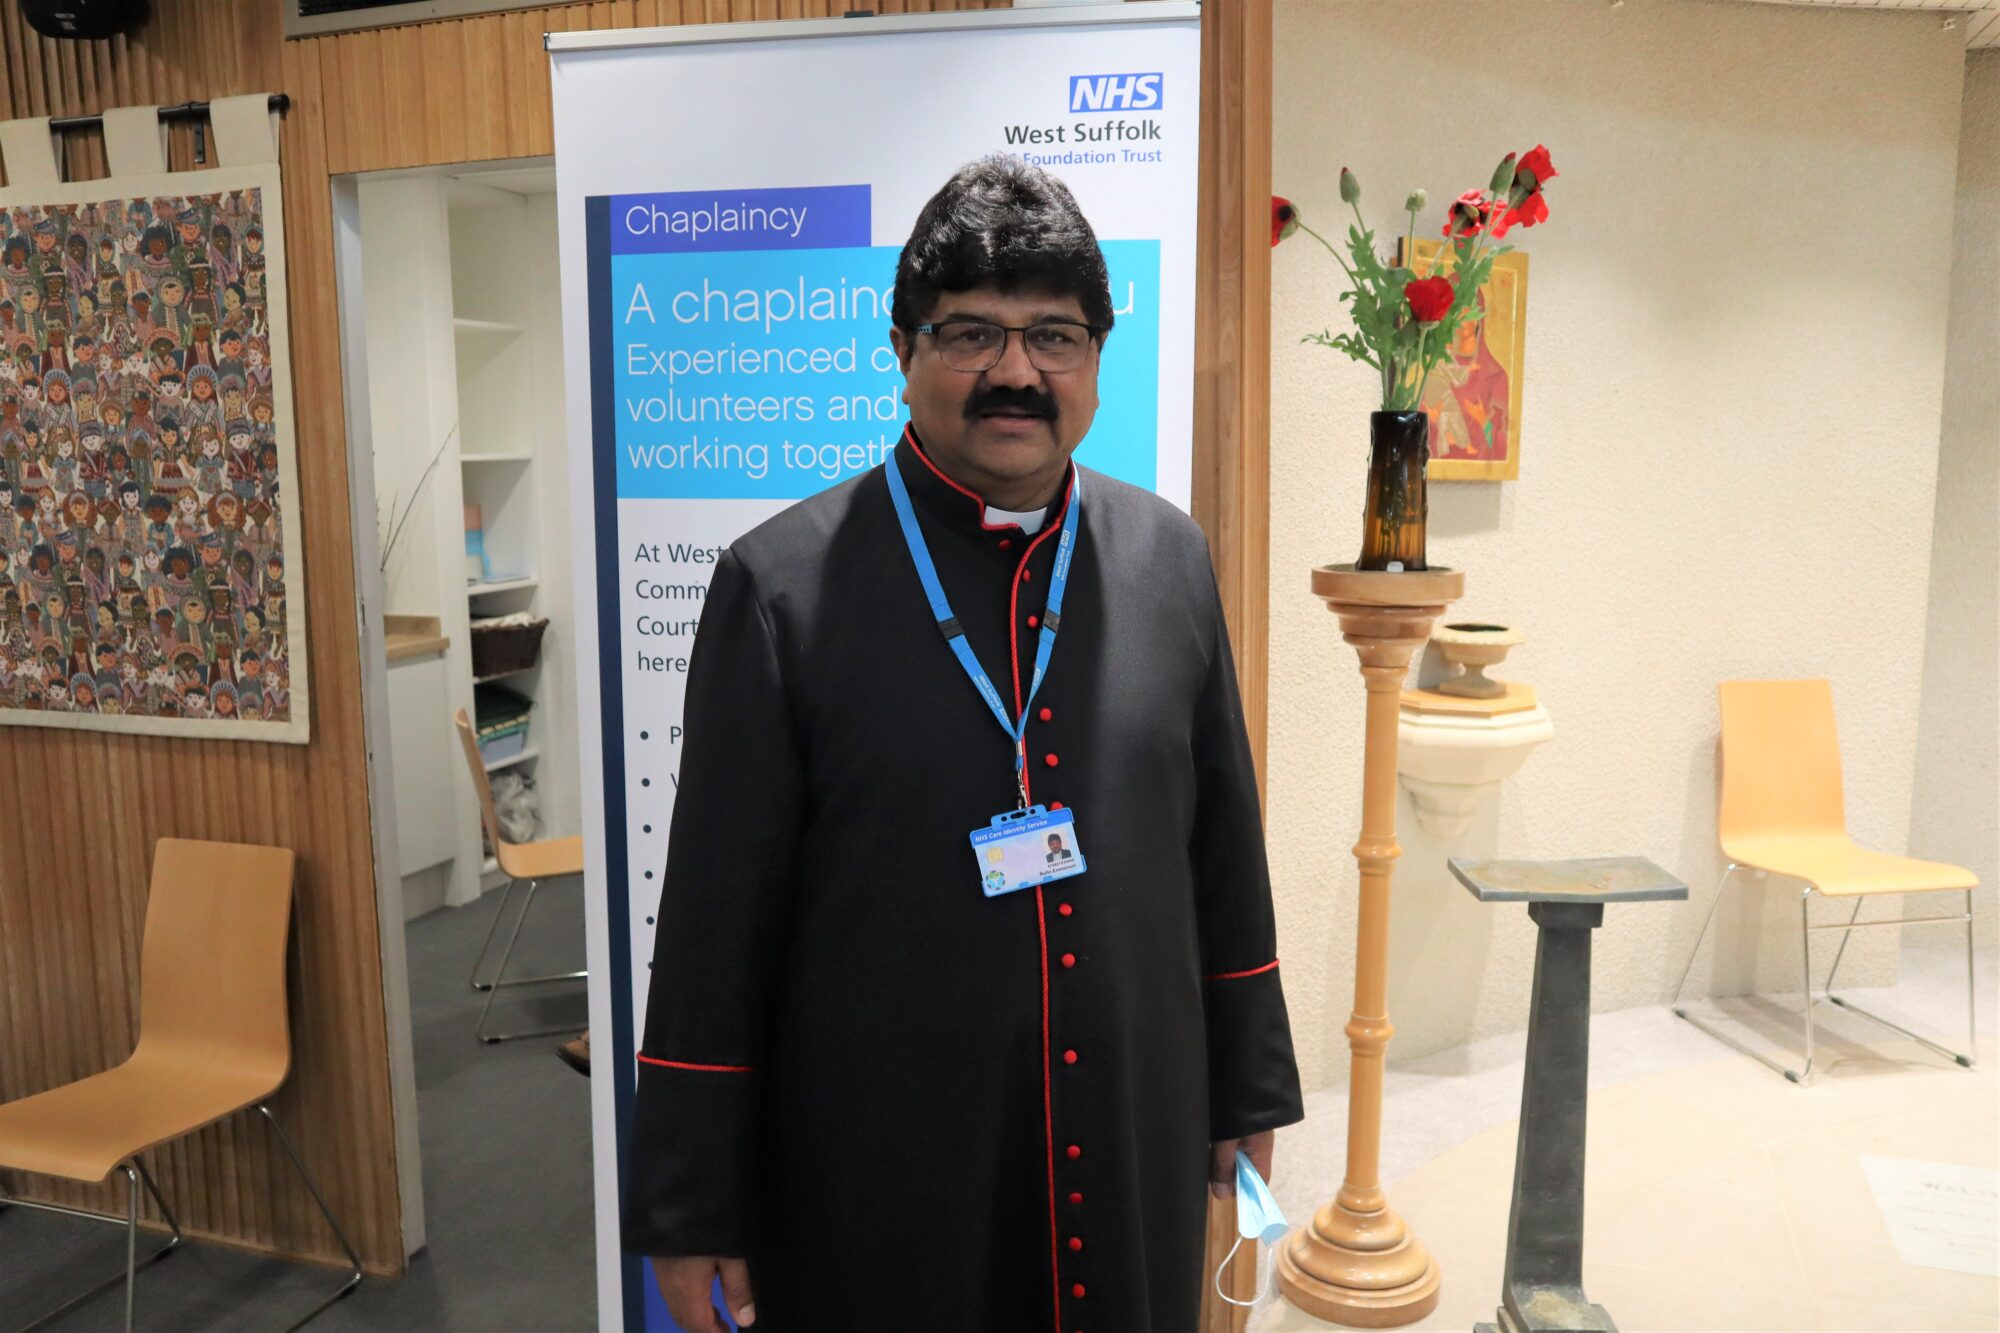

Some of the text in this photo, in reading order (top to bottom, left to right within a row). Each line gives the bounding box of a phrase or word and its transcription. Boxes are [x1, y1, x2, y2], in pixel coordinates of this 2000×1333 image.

[1070, 74, 1161, 111] NHS
[1004, 119, 1162, 145] West Suffolk
[1023, 150, 1116, 166] Foundation
[1121, 149, 1163, 163] Trust
[625, 201, 807, 241] Chaplaincy
[624, 282, 656, 324] A
[627, 337, 857, 385] Experienced
[626, 385, 898, 423] volunteers and
[627, 435, 769, 480] working
[634, 543, 661, 563] At
[638, 650, 687, 672] here
[975, 819, 1048, 843] NHS Care Identity Service
